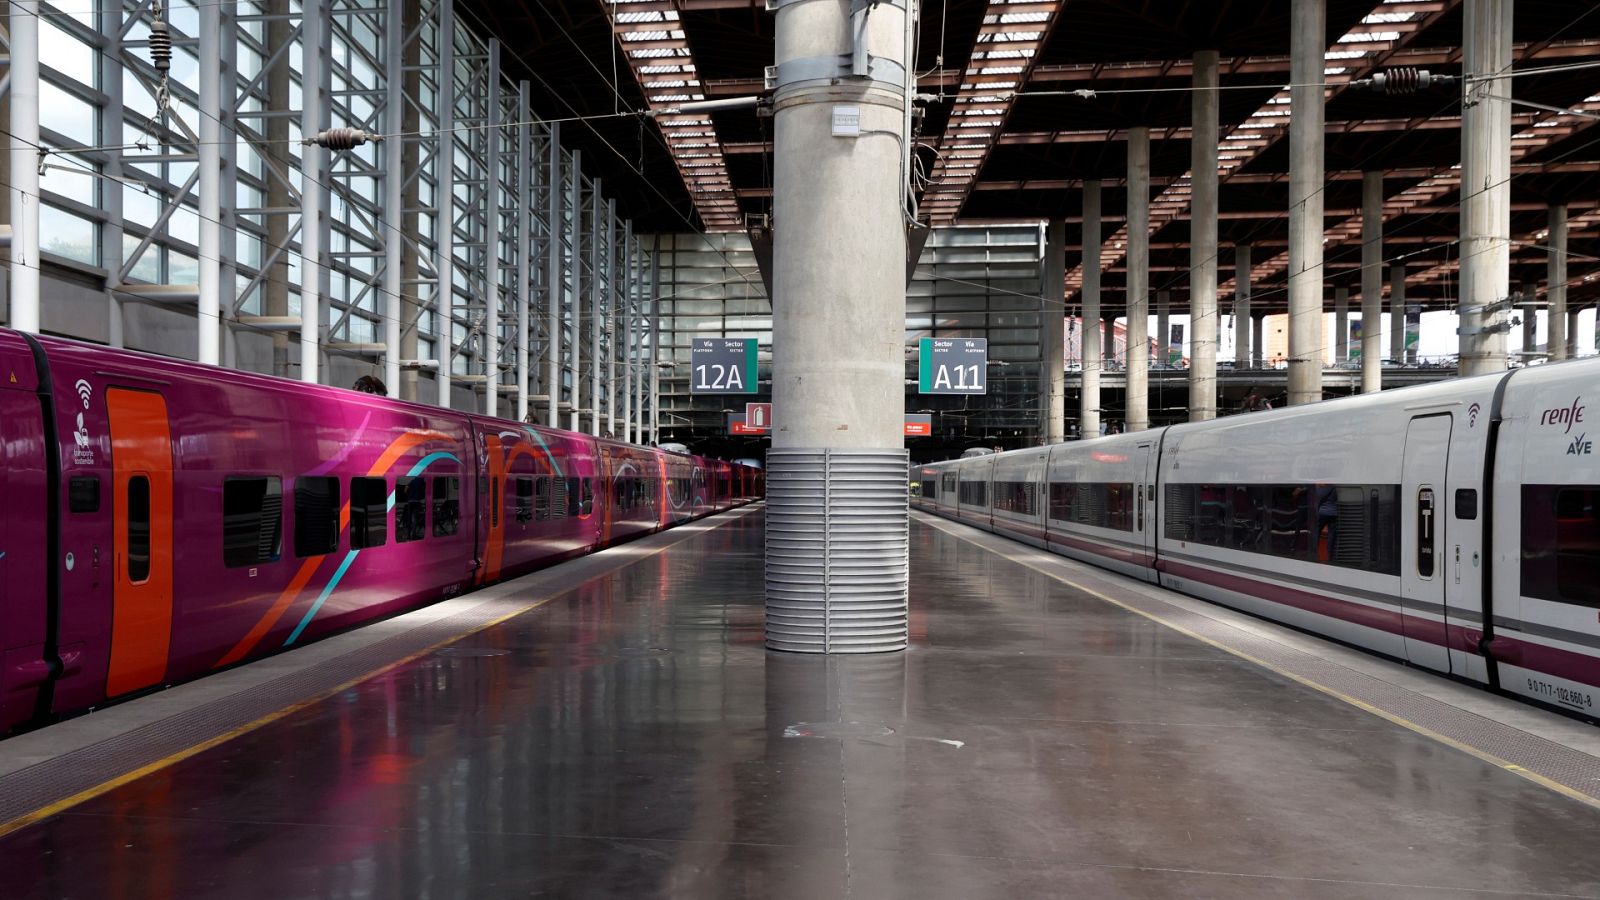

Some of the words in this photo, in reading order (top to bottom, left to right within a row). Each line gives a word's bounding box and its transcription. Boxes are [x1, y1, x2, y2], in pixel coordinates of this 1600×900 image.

[696, 364, 743, 389] 12A
[1540, 396, 1586, 434] renfe
[1566, 432, 1593, 456] AVE
